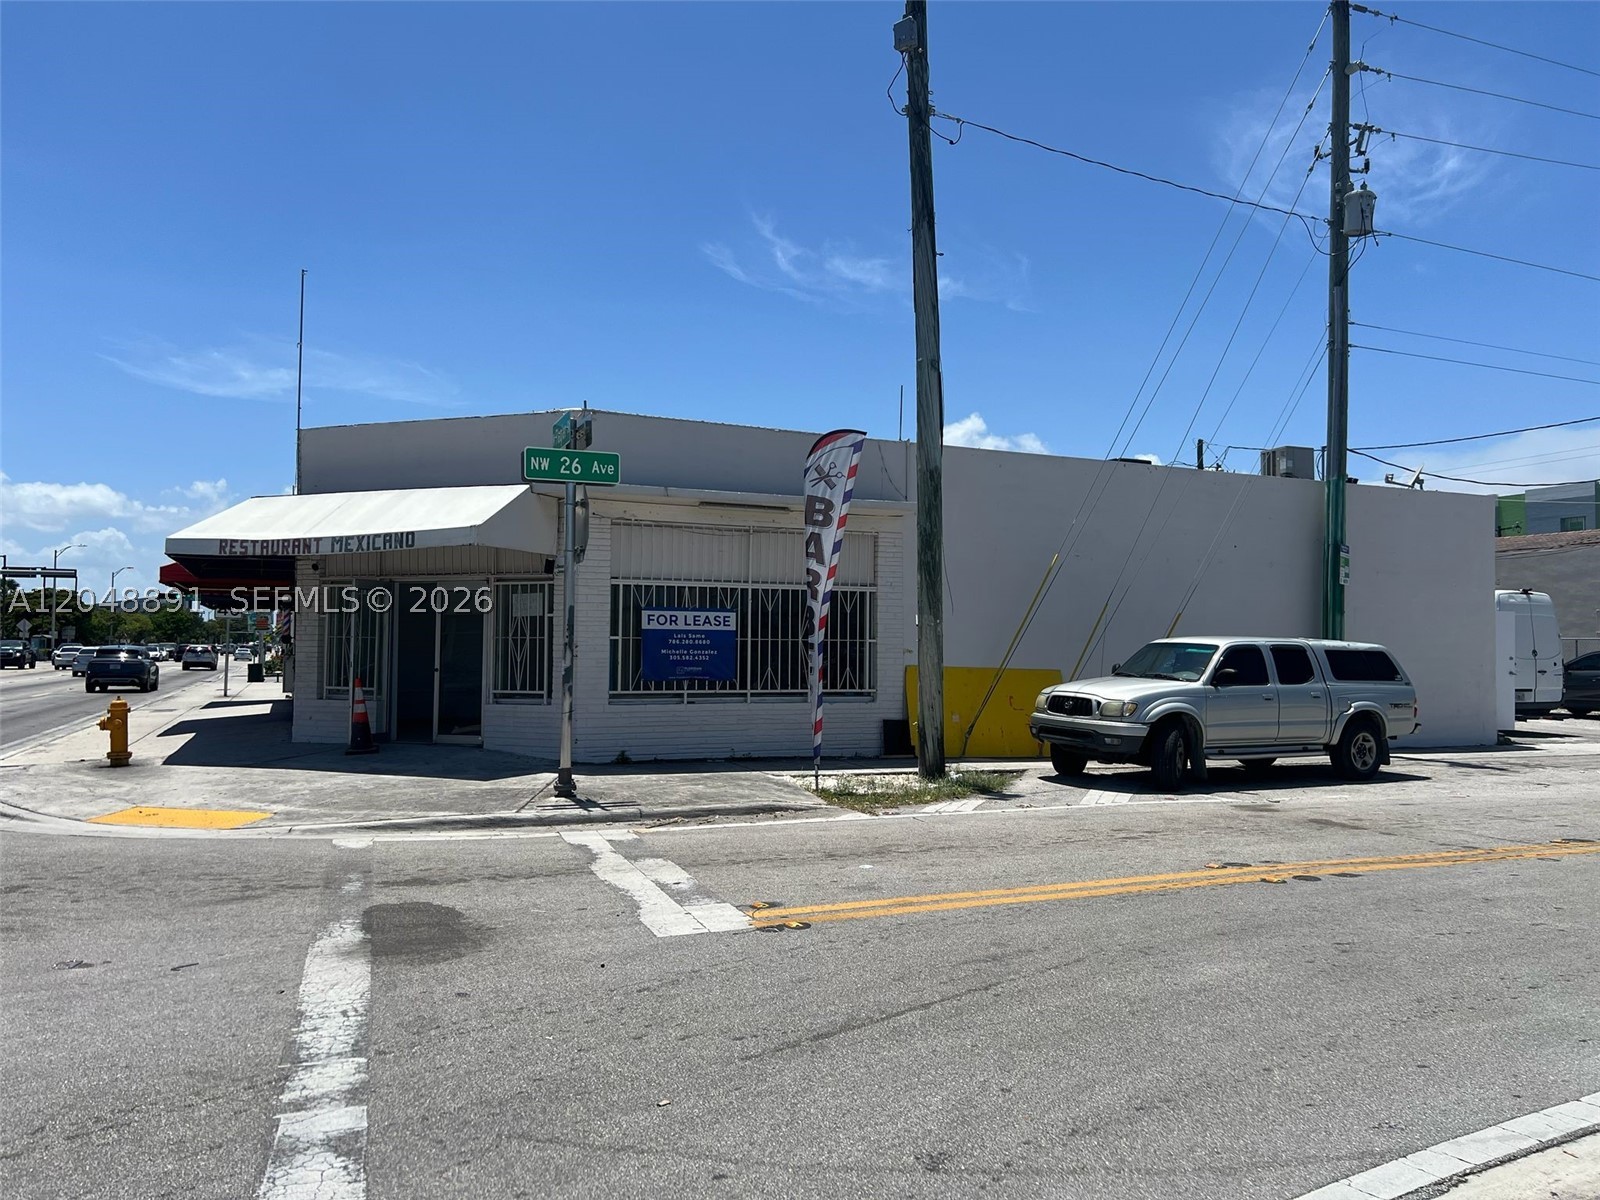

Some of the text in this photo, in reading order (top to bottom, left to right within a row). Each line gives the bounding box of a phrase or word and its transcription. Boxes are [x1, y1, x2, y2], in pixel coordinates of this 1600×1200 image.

[530, 456, 615, 475] NW 26 Ave
[219, 531, 416, 555] RESTAURANT MEXICANO
[647, 614, 731, 627] FOR LEASE
